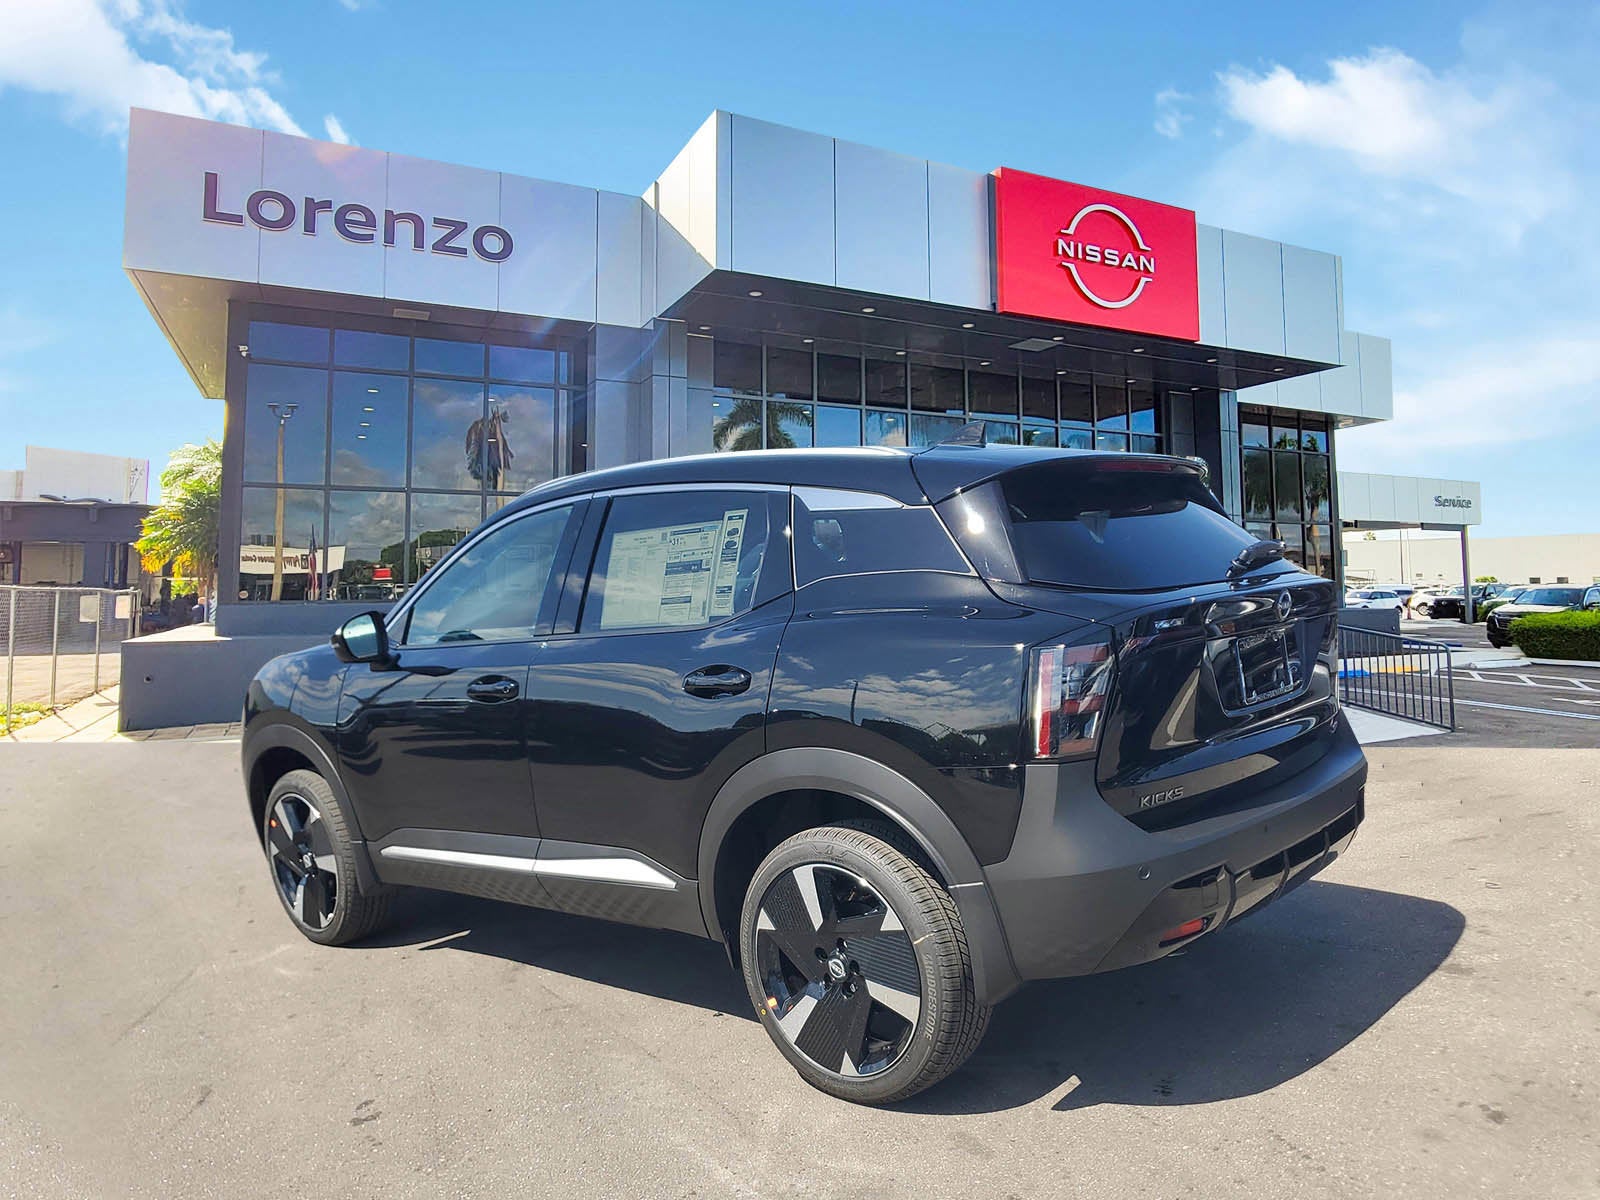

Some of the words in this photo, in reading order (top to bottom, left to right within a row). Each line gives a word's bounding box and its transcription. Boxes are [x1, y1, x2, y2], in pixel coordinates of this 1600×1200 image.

[203, 171, 514, 263] Lorenzo
[1057, 238, 1155, 273] NISSAN
[1433, 495, 1472, 509] Service
[1139, 786, 1184, 808] KICKS
